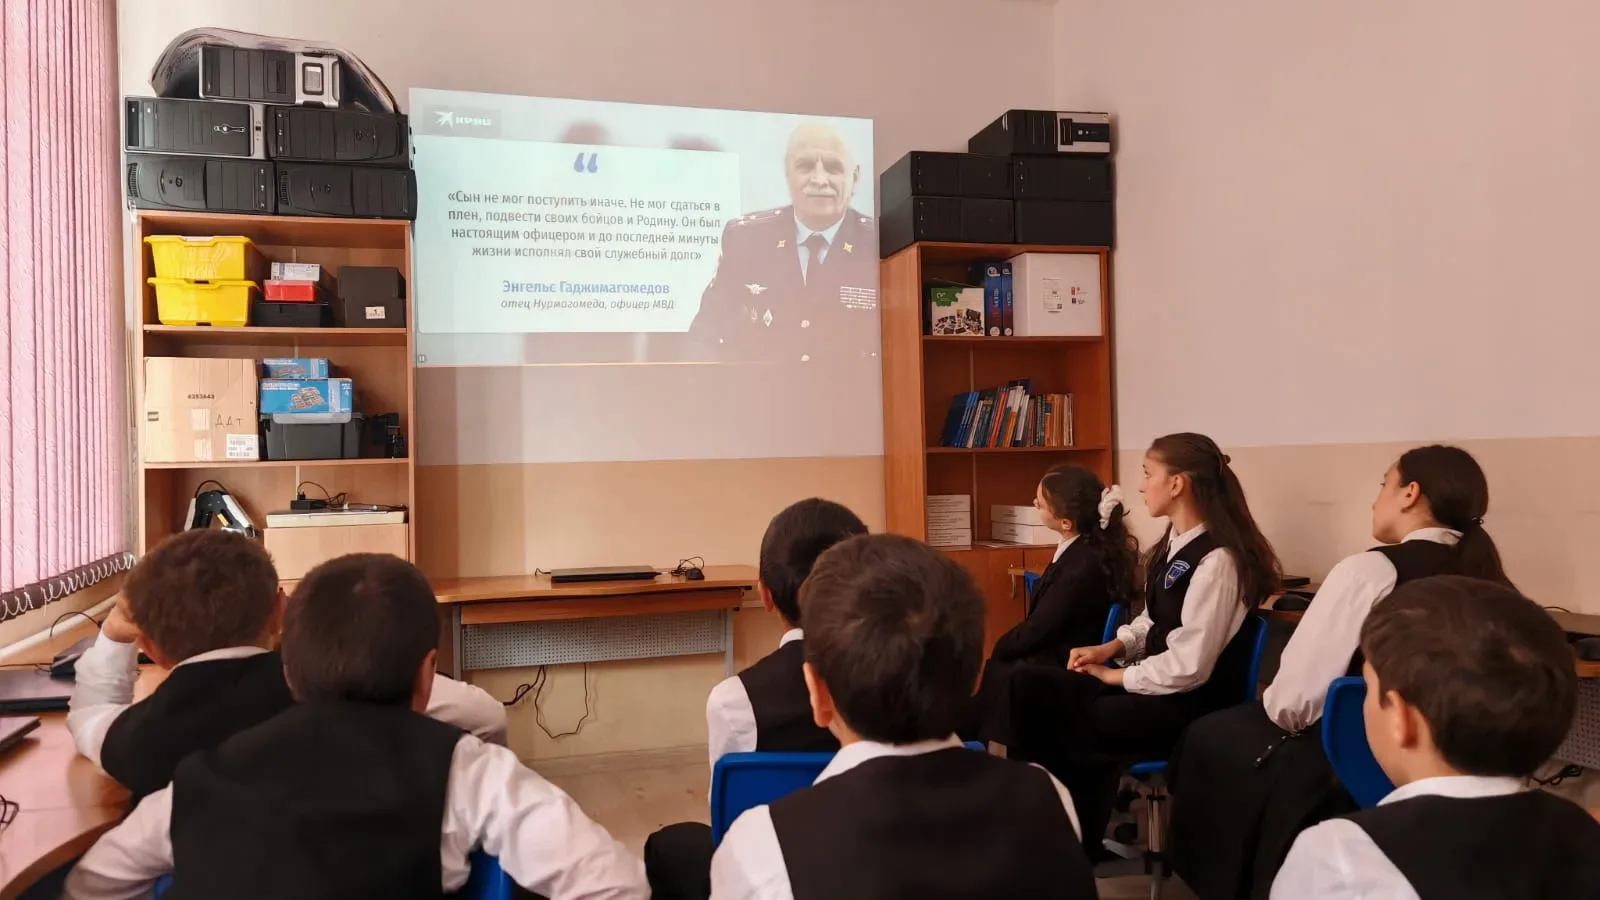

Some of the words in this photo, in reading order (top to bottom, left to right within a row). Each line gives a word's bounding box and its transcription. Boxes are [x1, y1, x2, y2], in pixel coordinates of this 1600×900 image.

[448, 191, 480, 203] «Сын
[485, 194, 499, 204] не
[502, 194, 524, 205] мог
[528, 195, 587, 208] поступить
[591, 198, 627, 208] иначе.
[630, 197, 645, 209] Не
[648, 200, 667, 210] мог
[671, 201, 710, 212] сдаться
[714, 202, 720, 212] в
[448, 210, 482, 222] плен,
[486, 211, 541, 223] подвести
[545, 213, 578, 224] своих
[581, 212, 624, 226] бойцов
[627, 216, 633, 225] и
[637, 215, 678, 228] Родину.
[681, 216, 696, 227] Он
[699, 216, 720, 228] был
[451, 228, 519, 240] настоящим
[523, 228, 585, 242] офицером
[589, 232, 595, 241] и
[599, 232, 612, 242] до
[615, 231, 675, 243] последней
[678, 234, 718, 245] минуты
[472, 247, 511, 257] жизни
[515, 247, 571, 258] исполнял
[574, 246, 601, 258] свой
[605, 248, 667, 261] служебный
[671, 250, 702, 261] долг»
[502, 280, 557, 293] Энгельс
[560, 281, 670, 296] Гаджимагомедов
[500, 300, 530, 310] отец
[533, 299, 608, 311] Нурмагомеда,
[610, 299, 650, 311] офицер
[653, 300, 674, 310] МВД
